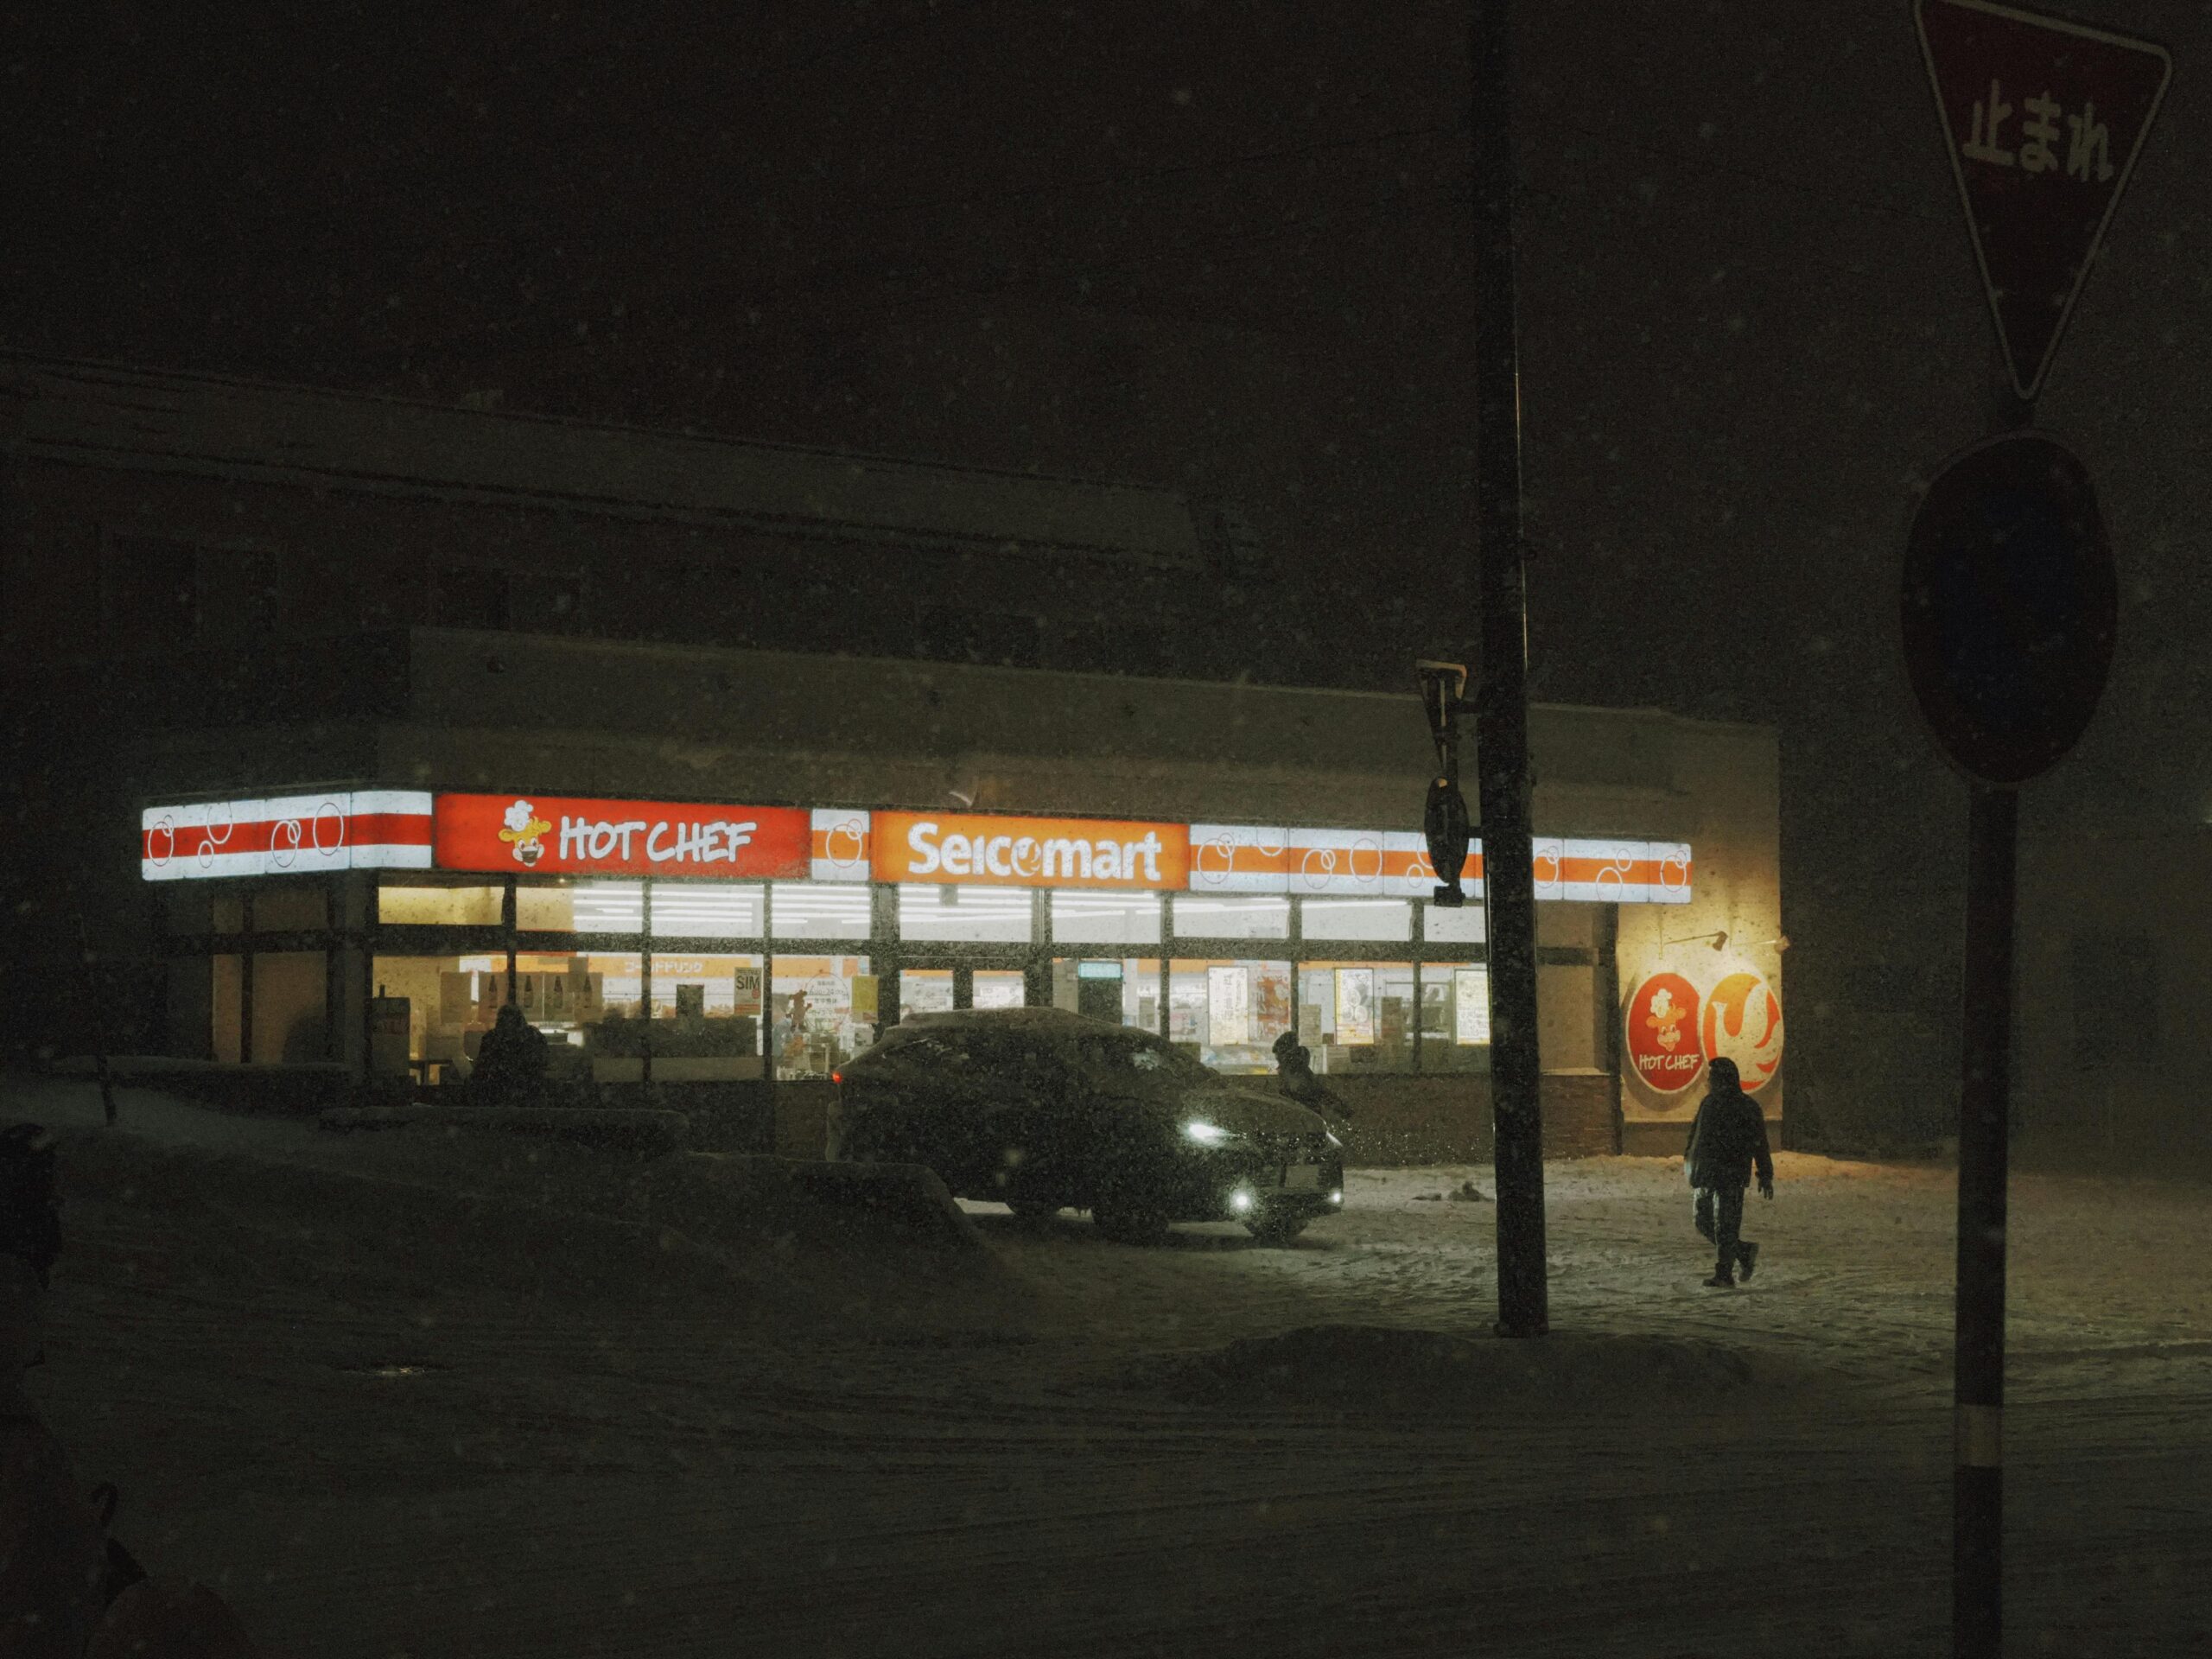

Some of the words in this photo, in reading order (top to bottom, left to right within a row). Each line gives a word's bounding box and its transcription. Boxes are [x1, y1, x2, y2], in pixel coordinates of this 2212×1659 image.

[1962, 78, 2114, 182] 止まれ
[560, 816, 646, 861] HOT
[646, 821, 757, 862] CHEF
[736, 976, 760, 990] SIM
[1639, 1054, 1665, 1071] HOT
[1665, 1054, 1700, 1071] CHEF
